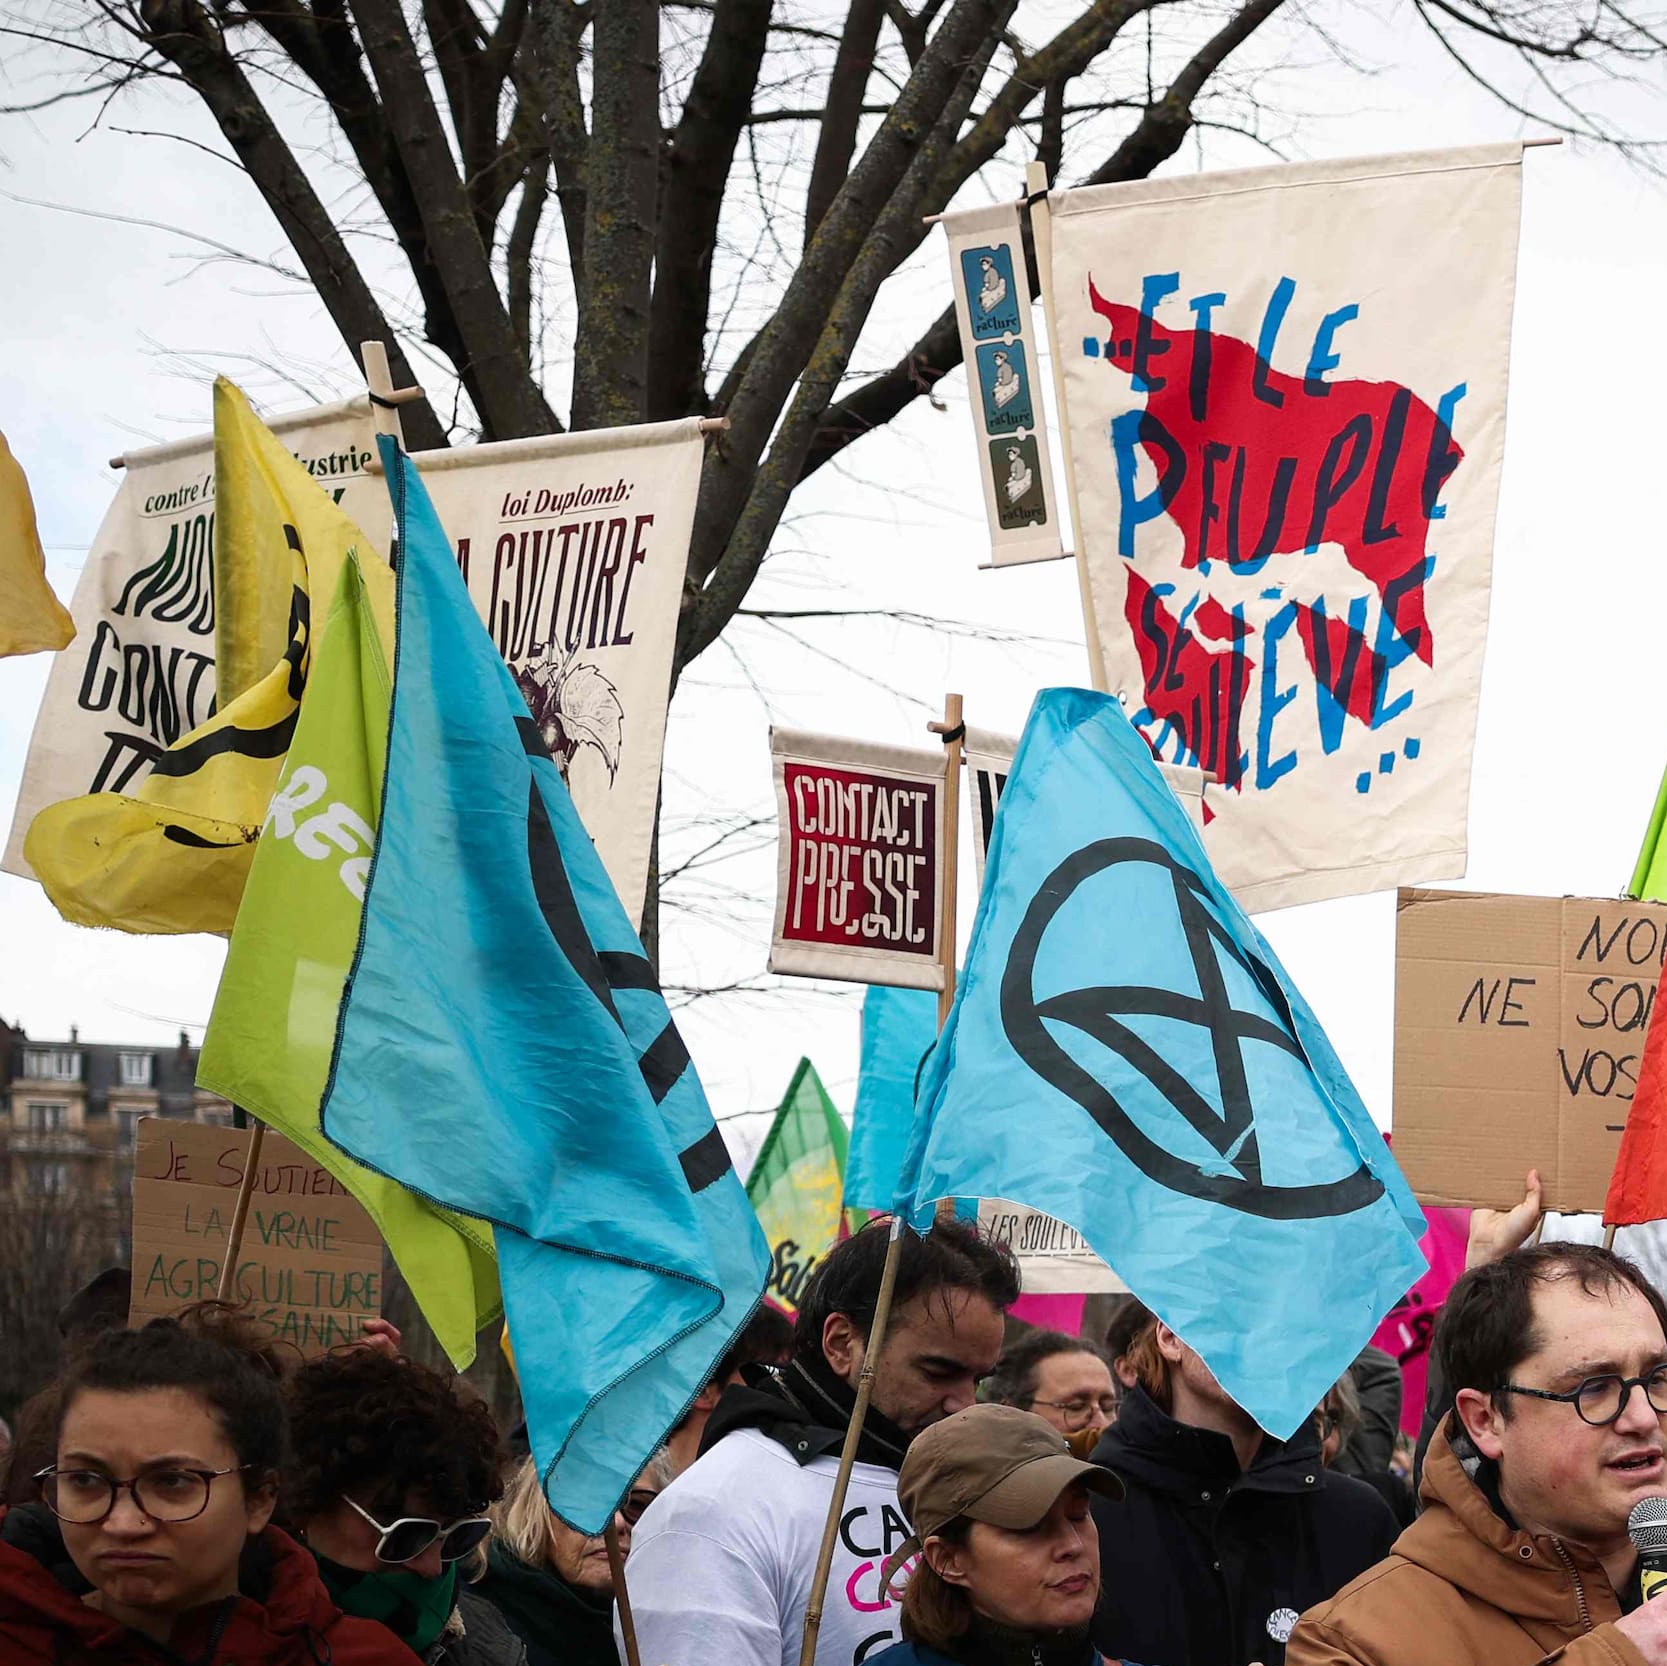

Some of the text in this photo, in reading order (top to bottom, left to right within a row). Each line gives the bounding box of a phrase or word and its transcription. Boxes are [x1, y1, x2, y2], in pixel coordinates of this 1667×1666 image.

[1252, 275, 1360, 410] LE
[145, 481, 199, 513] contre
[501, 479, 635, 518] loi Duplomb:
[1110, 382, 1468, 578] PEUPLE
[487, 513, 655, 663] CULTURE
[77, 620, 217, 749] CONT
[793, 775, 929, 849] CONTACT
[792, 838, 927, 944] PRESSE
[1458, 977, 1537, 1027] NE
[1556, 1048, 1639, 1101] VOS
[155, 1141, 350, 1197] JE SUTIE
[184, 1203, 342, 1252] LA VRAIE
[143, 1253, 380, 1309] AGRCULTURE
[258, 1307, 376, 1347] SANNE
[840, 1504, 912, 1559] CA
